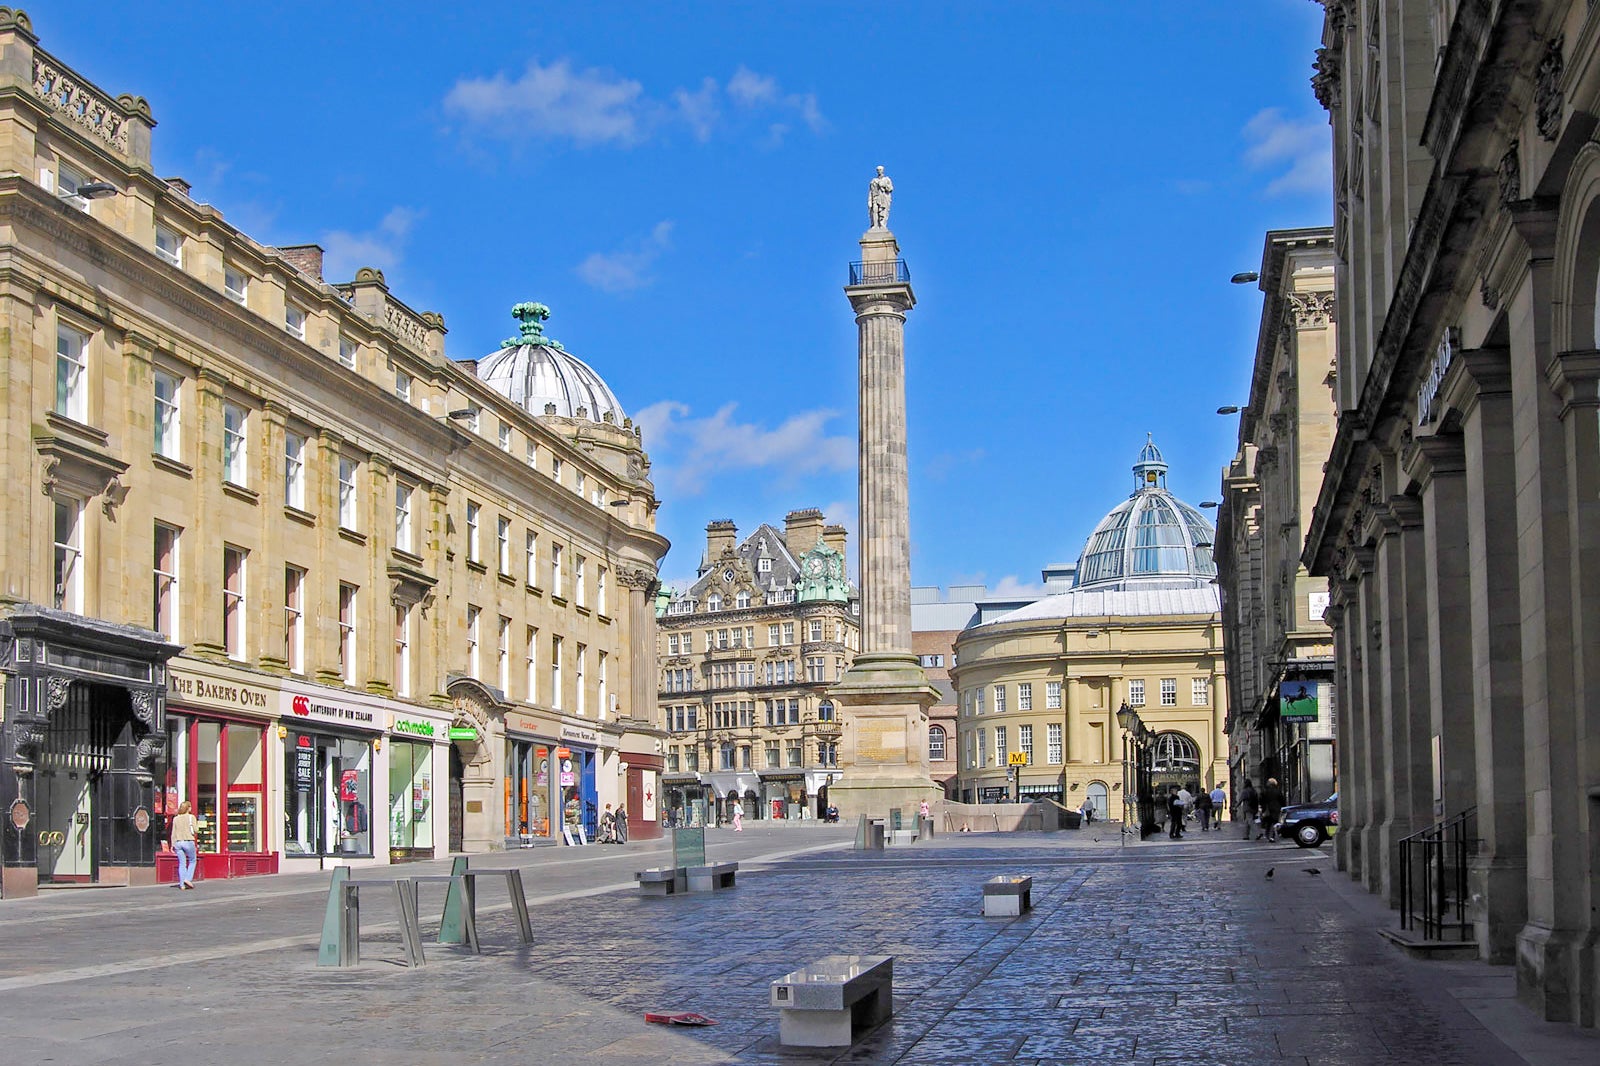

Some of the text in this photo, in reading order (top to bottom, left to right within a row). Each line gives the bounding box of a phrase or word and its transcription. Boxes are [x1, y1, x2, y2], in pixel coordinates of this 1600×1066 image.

[170, 675, 267, 707] THE BAKER'S OVEN
[310, 703, 373, 723] CANTERBURY OF NEW ZEALAND
[1012, 753, 1022, 763] M
[298, 767, 311, 778] SALE
